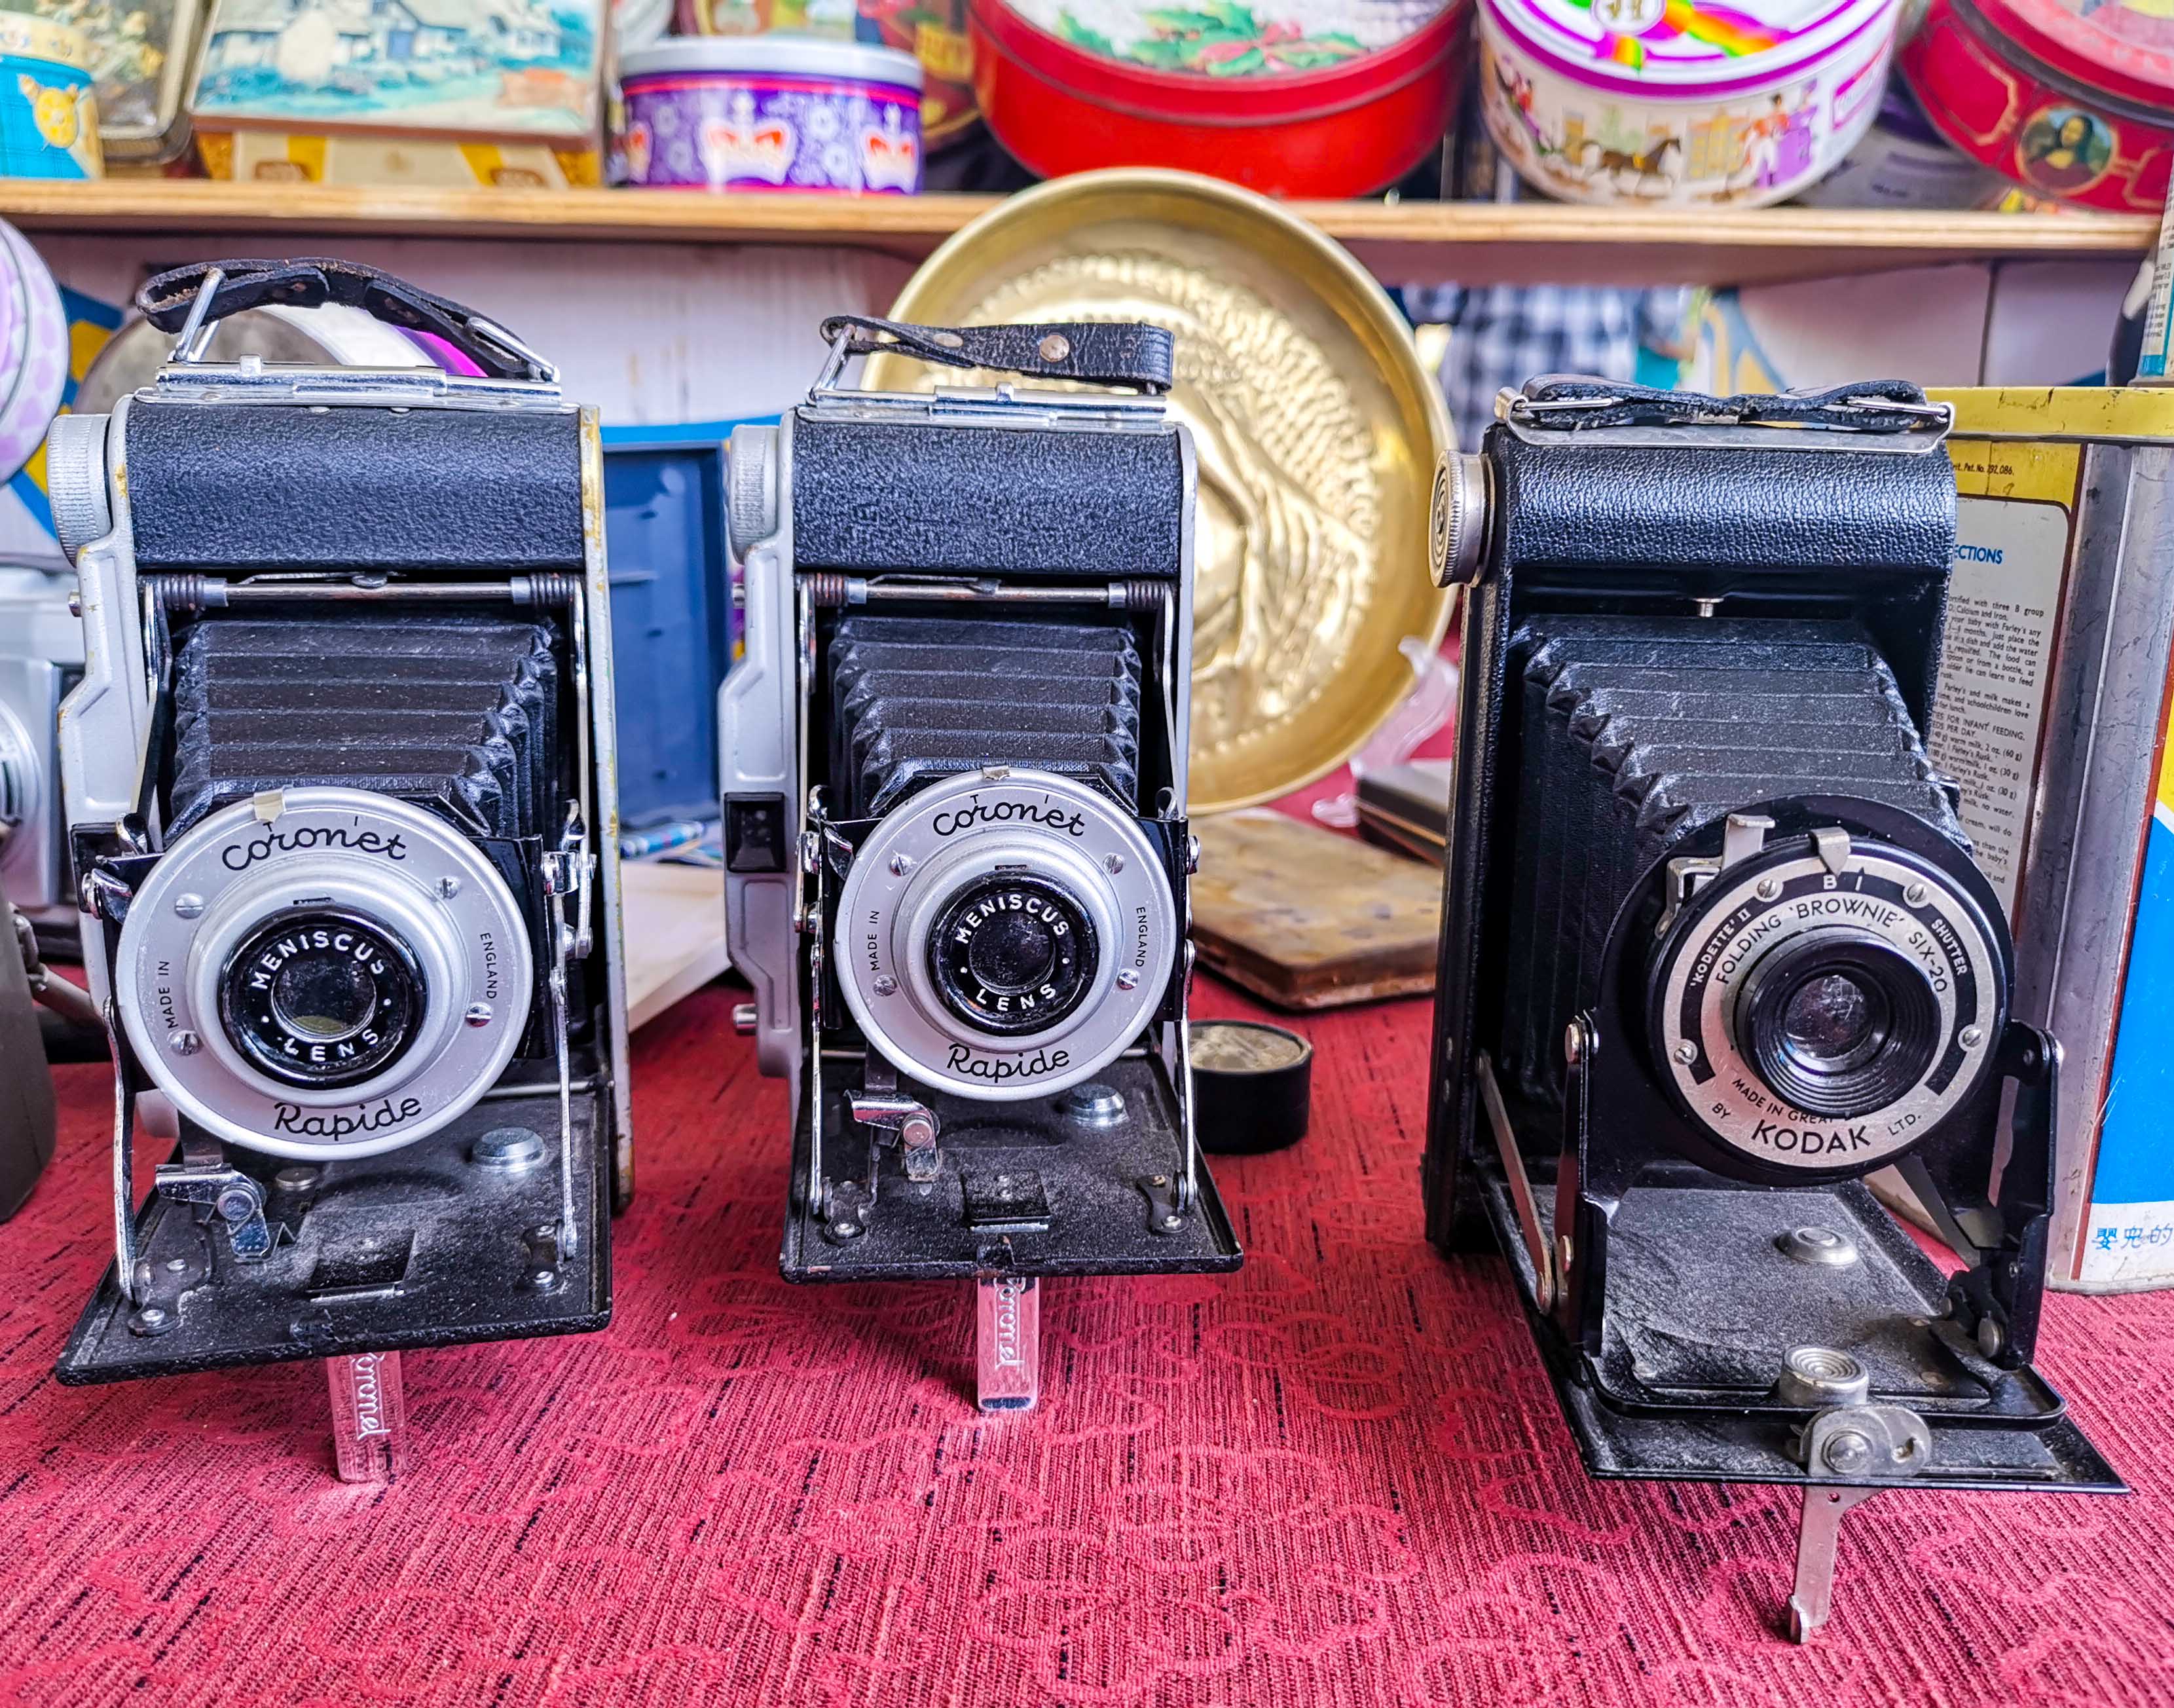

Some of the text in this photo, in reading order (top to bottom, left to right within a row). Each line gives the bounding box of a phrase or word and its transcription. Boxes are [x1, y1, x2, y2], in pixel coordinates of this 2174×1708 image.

[1954, 544, 2004, 565] ECTIONS
[1992, 601, 2010, 611] three
[2024, 608, 2044, 618] group
[1968, 618, 1981, 627] baby
[2002, 622, 2026, 635] Farley's
[2029, 629, 2042, 639] any
[2007, 634, 2025, 644] place
[2028, 637, 2040, 647] the
[1980, 640, 1991, 648] and
[1993, 642, 2004, 651] add
[2006, 644, 2017, 653] the
[2019, 648, 2038, 656] water
[1989, 650, 2001, 660] The
[2005, 653, 2021, 663] food
[1976, 658, 1992, 668] from
[1989, 670, 2005, 682] learn
[2019, 676, 2034, 686] feed
[1966, 698, 2012, 715] schoolchildren
[2014, 708, 2029, 719] love
[2002, 697, 2022, 707] makes
[1946, 714, 1960, 724] FOR
[1963, 718, 1990, 732] INFANT
[1992, 724, 2025, 741] FEEDING.
[1946, 723, 1959, 733] PER
[932, 802, 1086, 837] Coronet
[1981, 803, 1991, 811] no
[1989, 825, 2001, 834] will
[2002, 828, 2012, 837] do
[222, 827, 407, 871] Coronet
[1981, 841, 1996, 851] than
[1998, 845, 2010, 856] the
[1987, 852, 2008, 865] baby's
[1822, 874, 1837, 890] B
[955, 893, 1069, 944] MENISCUS
[1739, 907, 1752, 923] II
[867, 910, 881, 971] MADE IN
[1136, 906, 1146, 968] ENGLAND
[1931, 918, 1968, 976] SHUTTER
[250, 930, 385, 990] MENISCUS
[479, 932, 498, 1000] ENGLAND
[1715, 914, 1782, 986] FOLDING
[1908, 931, 1948, 993] SIX-20
[158, 960, 179, 1029] MADE IN
[976, 983, 1056, 1012] LENS
[283, 1028, 379, 1062] LENS
[946, 1043, 1070, 1084] Rapide
[1731, 1078, 1767, 1109] MADE
[1767, 1102, 1784, 1117] IN
[274, 1098, 422, 1142] Rapide
[1711, 1102, 1923, 1155] BY KODAK LTD.
[349, 1352, 392, 1441] oronet
